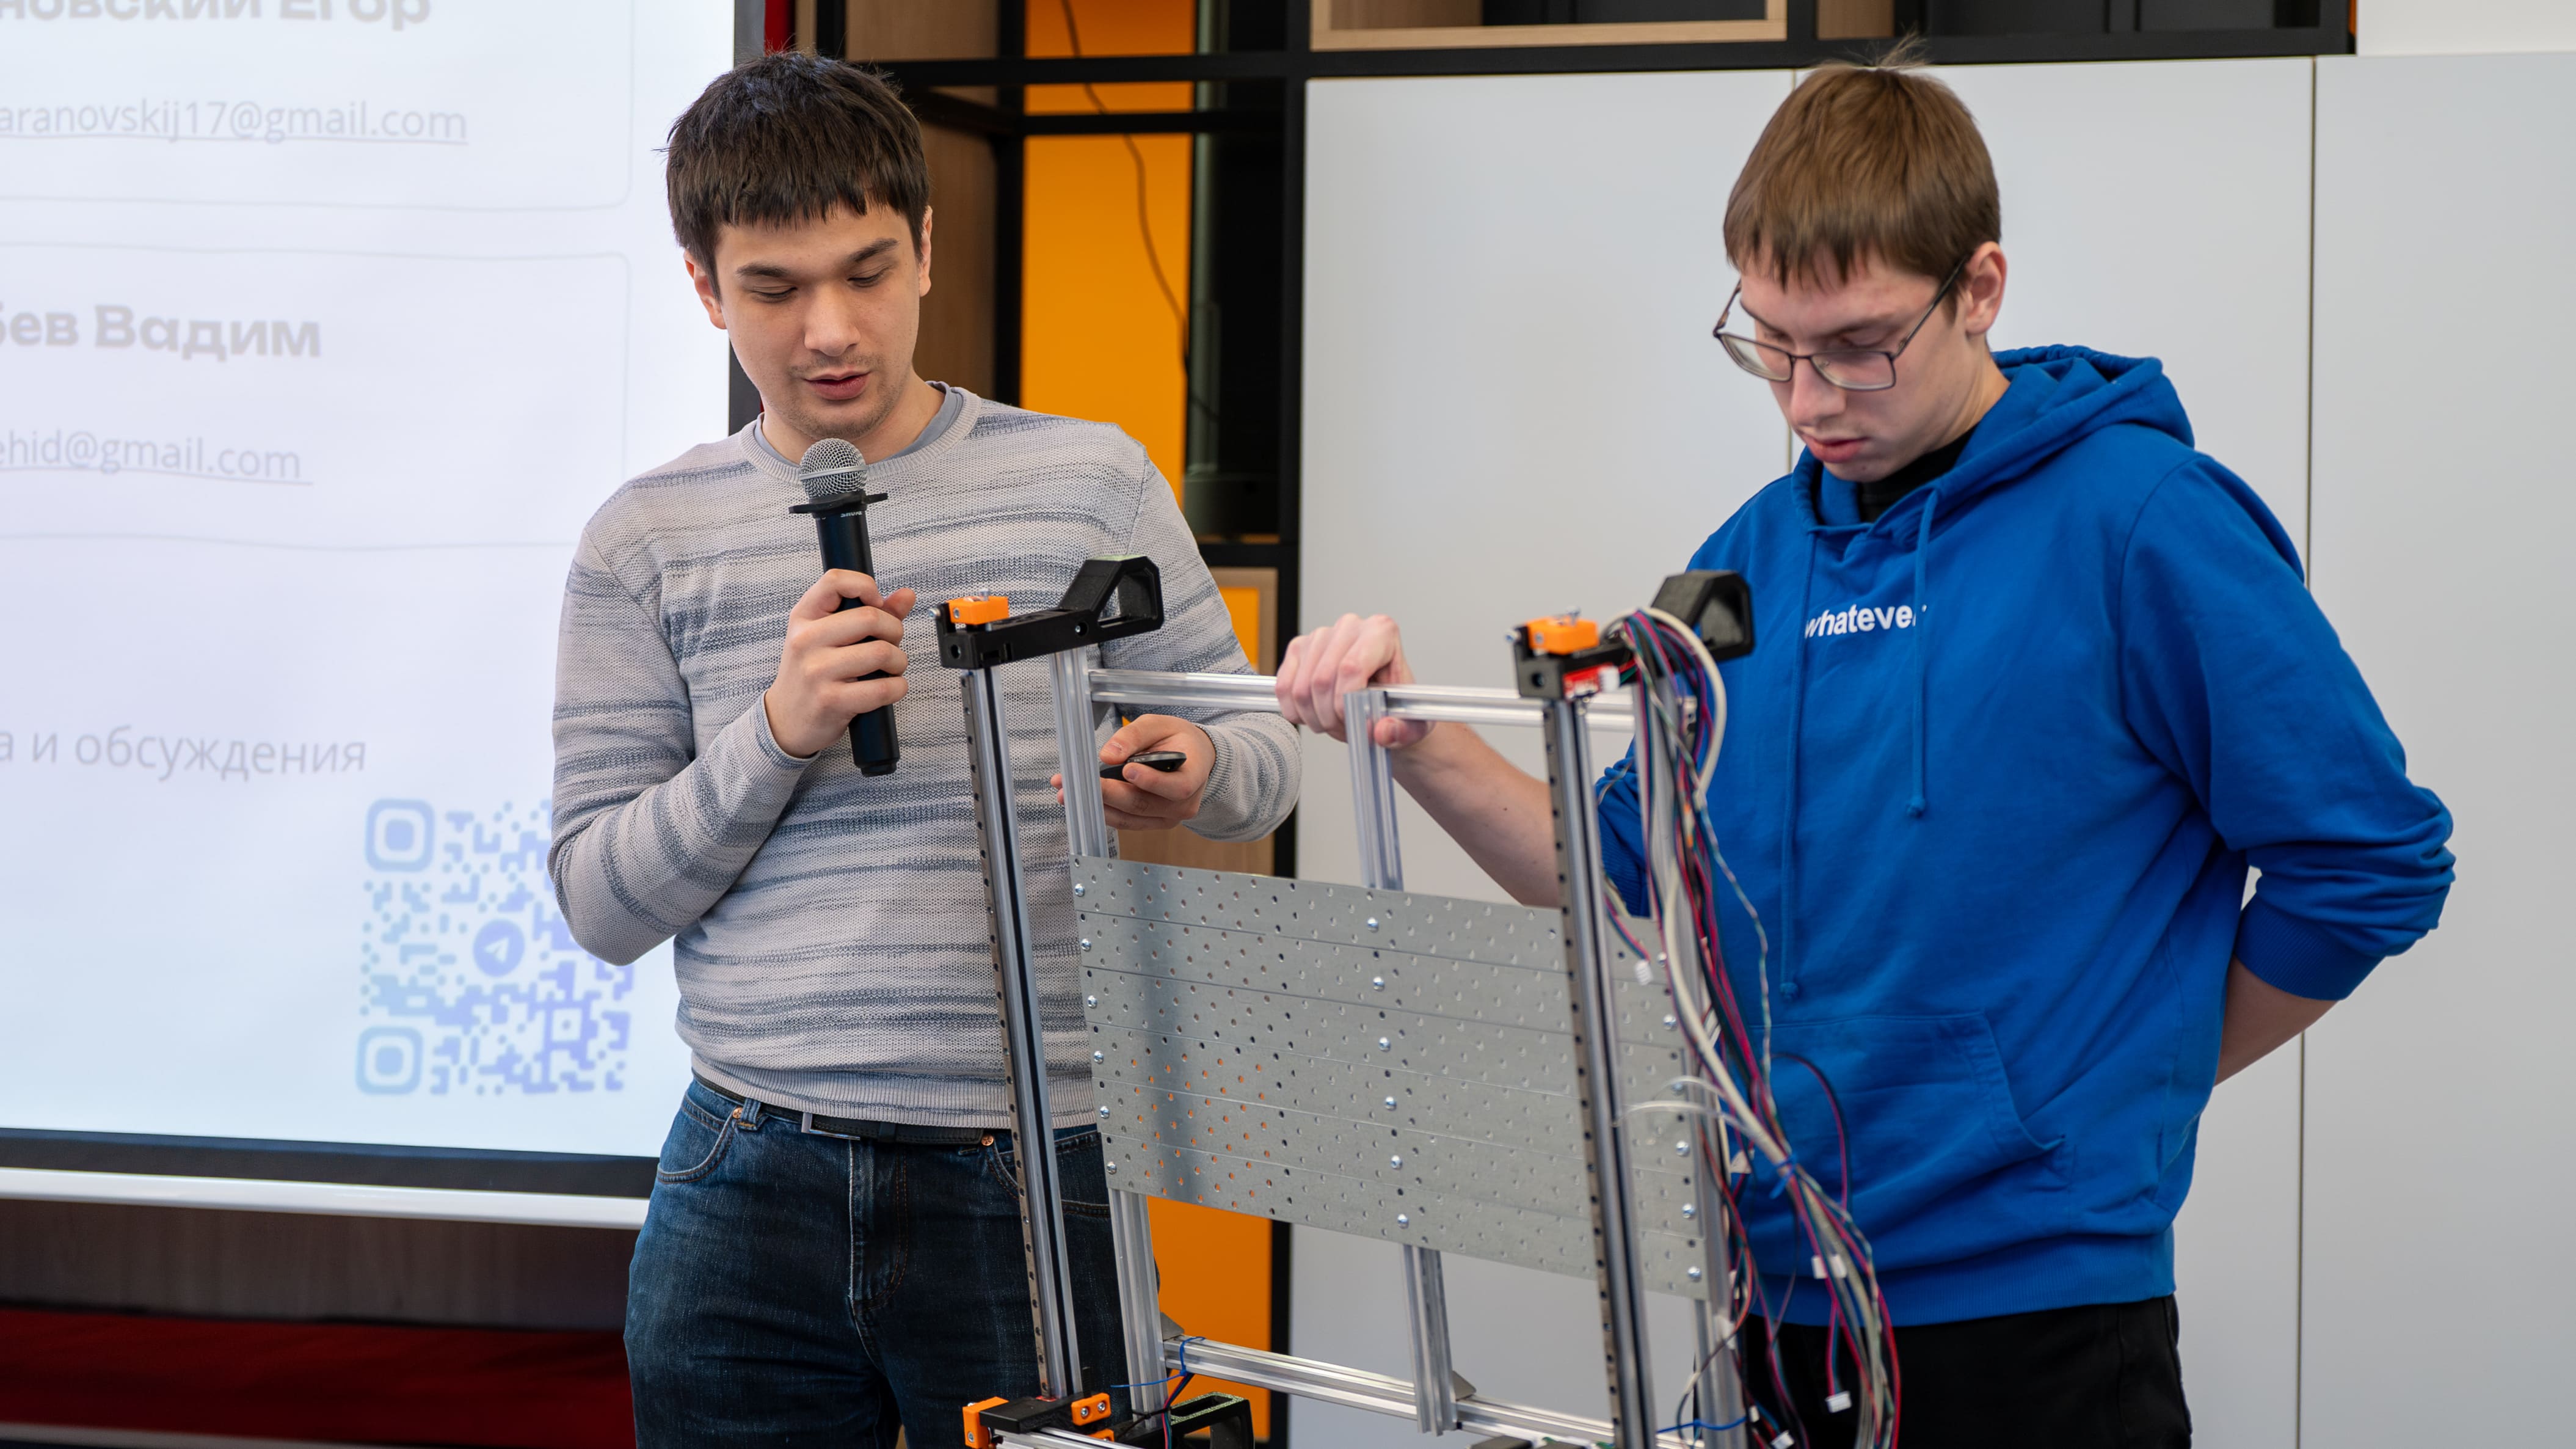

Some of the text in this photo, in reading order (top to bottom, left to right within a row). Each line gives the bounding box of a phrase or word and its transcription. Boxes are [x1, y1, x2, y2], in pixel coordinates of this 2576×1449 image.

[0, 98, 467, 143] aranovskij17@gmail.com
[0, 302, 321, 362] ев Вадим
[32, 731, 58, 764] и
[75, 724, 366, 783] обсуждения
